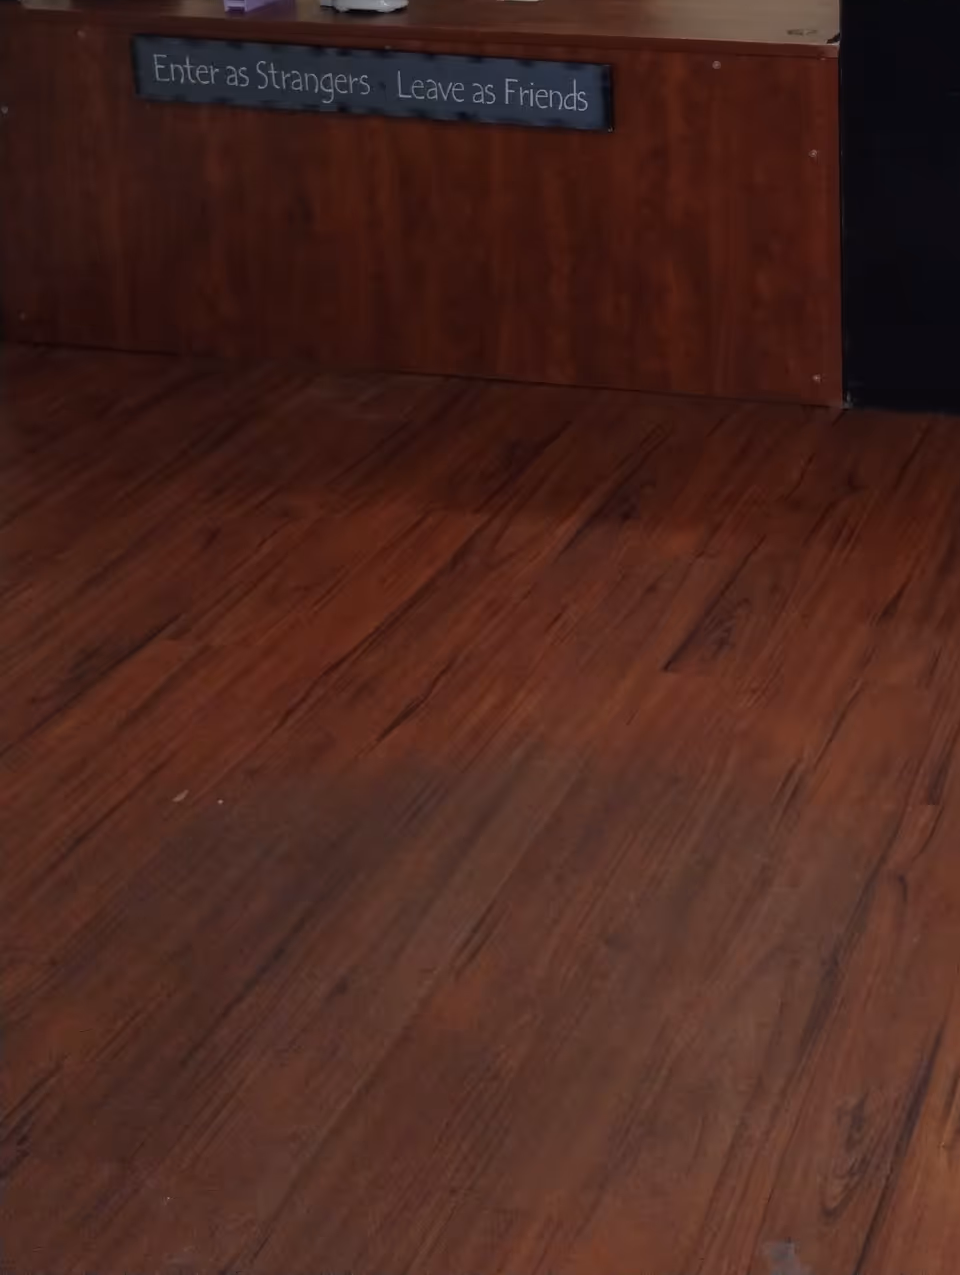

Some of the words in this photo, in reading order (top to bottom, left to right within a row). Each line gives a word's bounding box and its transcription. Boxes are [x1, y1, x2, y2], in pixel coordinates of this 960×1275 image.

[153, 53, 220, 86] Enter
[226, 66, 250, 88] as
[256, 60, 371, 104] Strangers
[397, 70, 466, 103] Leave
[472, 82, 497, 105] as
[504, 78, 589, 112] Friends
